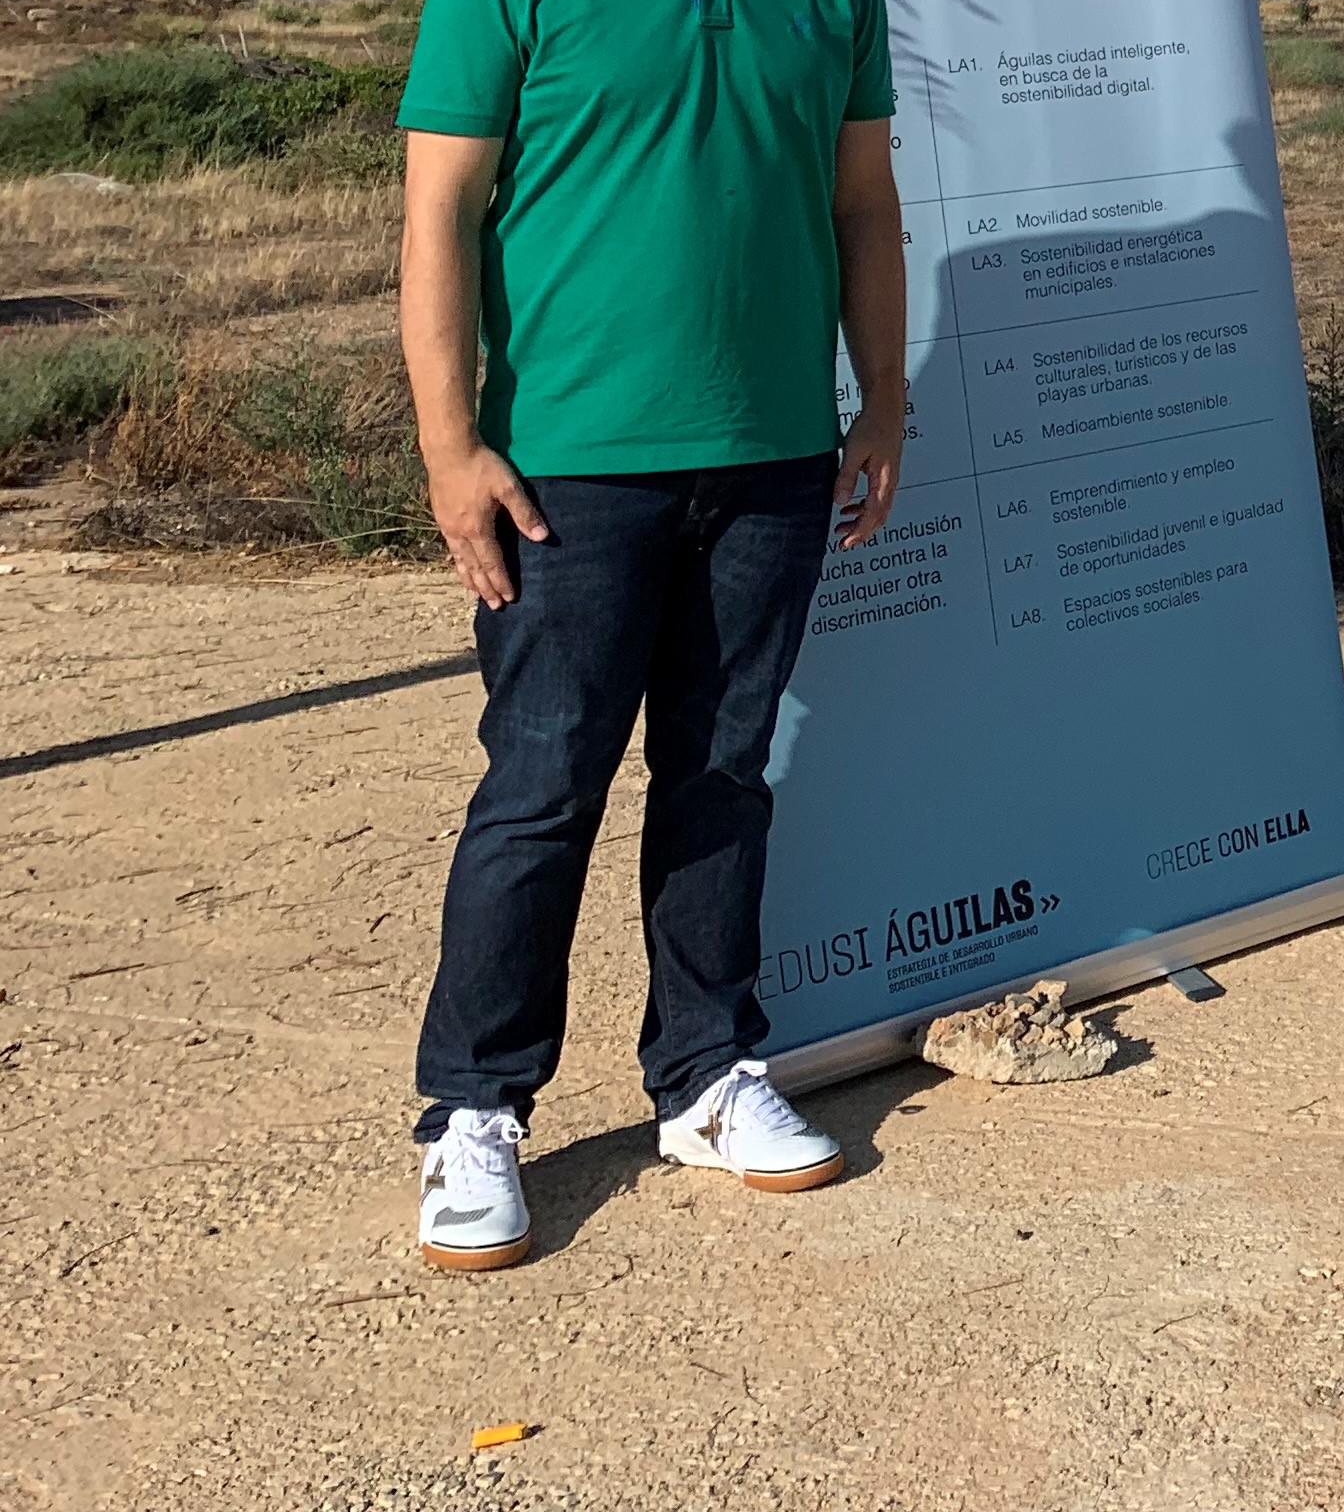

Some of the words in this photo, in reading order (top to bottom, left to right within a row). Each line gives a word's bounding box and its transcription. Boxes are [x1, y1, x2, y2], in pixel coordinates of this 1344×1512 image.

[948, 59, 982, 74] LA1.
[998, 51, 1053, 72] Águilas
[1057, 46, 1106, 65] ciudad
[1110, 41, 1190, 61] inteligente,
[1000, 74, 1018, 88] en
[1023, 68, 1068, 85] busca
[1072, 66, 1091, 81] de
[1095, 65, 1108, 79] la
[1002, 83, 1103, 104] sostenibilidad
[1107, 77, 1155, 96] digital.
[1016, 206, 1087, 229] Movilidad
[1092, 199, 1168, 220] sostenible.
[972, 253, 1006, 271] LA3.
[1021, 239, 1123, 264] Sostenibilidad
[1127, 229, 1203, 251] energética
[1023, 267, 1041, 282] en
[1046, 258, 1107, 278] edificios
[1110, 258, 1119, 268] e
[1123, 244, 1216, 268] instalaciones
[1025, 274, 1117, 300] municipales.
[984, 358, 1019, 376] LA4.
[1033, 341, 1136, 368] Sostenibilidad
[1139, 335, 1158, 351] de
[1161, 332, 1182, 348] los
[1186, 322, 1249, 343] recursos
[1035, 363, 1111, 386] culturales,
[1115, 351, 1177, 373] turísticos
[1180, 350, 1190, 364] y
[1193, 344, 1212, 360] de
[1215, 341, 1237, 356] las
[1037, 384, 1087, 406] playas
[1090, 373, 1153, 395] urbanas.
[1041, 407, 1154, 439] Medioambiente
[1158, 394, 1232, 419] sostenible.
[996, 499, 1031, 519] LA6.
[1050, 470, 1167, 506] Emprendimiento
[1171, 469, 1179, 484] y
[1183, 457, 1235, 479] empleo
[884, 514, 962, 544] inclusión
[1052, 497, 1130, 524] sostenible.
[1056, 524, 1159, 560] Sostenibilidad
[1162, 513, 1206, 539] juvenil
[1209, 515, 1218, 527] e
[1222, 498, 1284, 527] igualdad
[820, 559, 864, 581] ucha
[870, 548, 926, 571] contra
[932, 542, 948, 558] la
[1059, 561, 1079, 578] de
[818, 578, 901, 608] cualquier
[907, 569, 942, 589] otra
[1010, 608, 1046, 628] LA8.
[1063, 587, 1131, 614] Espacios
[1135, 568, 1212, 598] sostenibles
[1216, 560, 1248, 581] para
[811, 594, 947, 635] discriminación.
[1066, 603, 1140, 632] colectivos
[1146, 837, 1213, 879] CRECE
[1218, 823, 1259, 858] CON
[1263, 808, 1311, 844] ELLA
[758, 926, 873, 1002] EDUSI
[886, 879, 1035, 962] ÁGUILAS
[887, 956, 937, 980] ESTRATEGIA
[939, 953, 950, 965] DE
[952, 935, 1004, 961] DESARROLLO
[1006, 924, 1039, 945] URBANO
[889, 970, 941, 994] SOSTENIBLE
[942, 967, 948, 978] E
[949, 953, 996, 975] INTEGRADO
